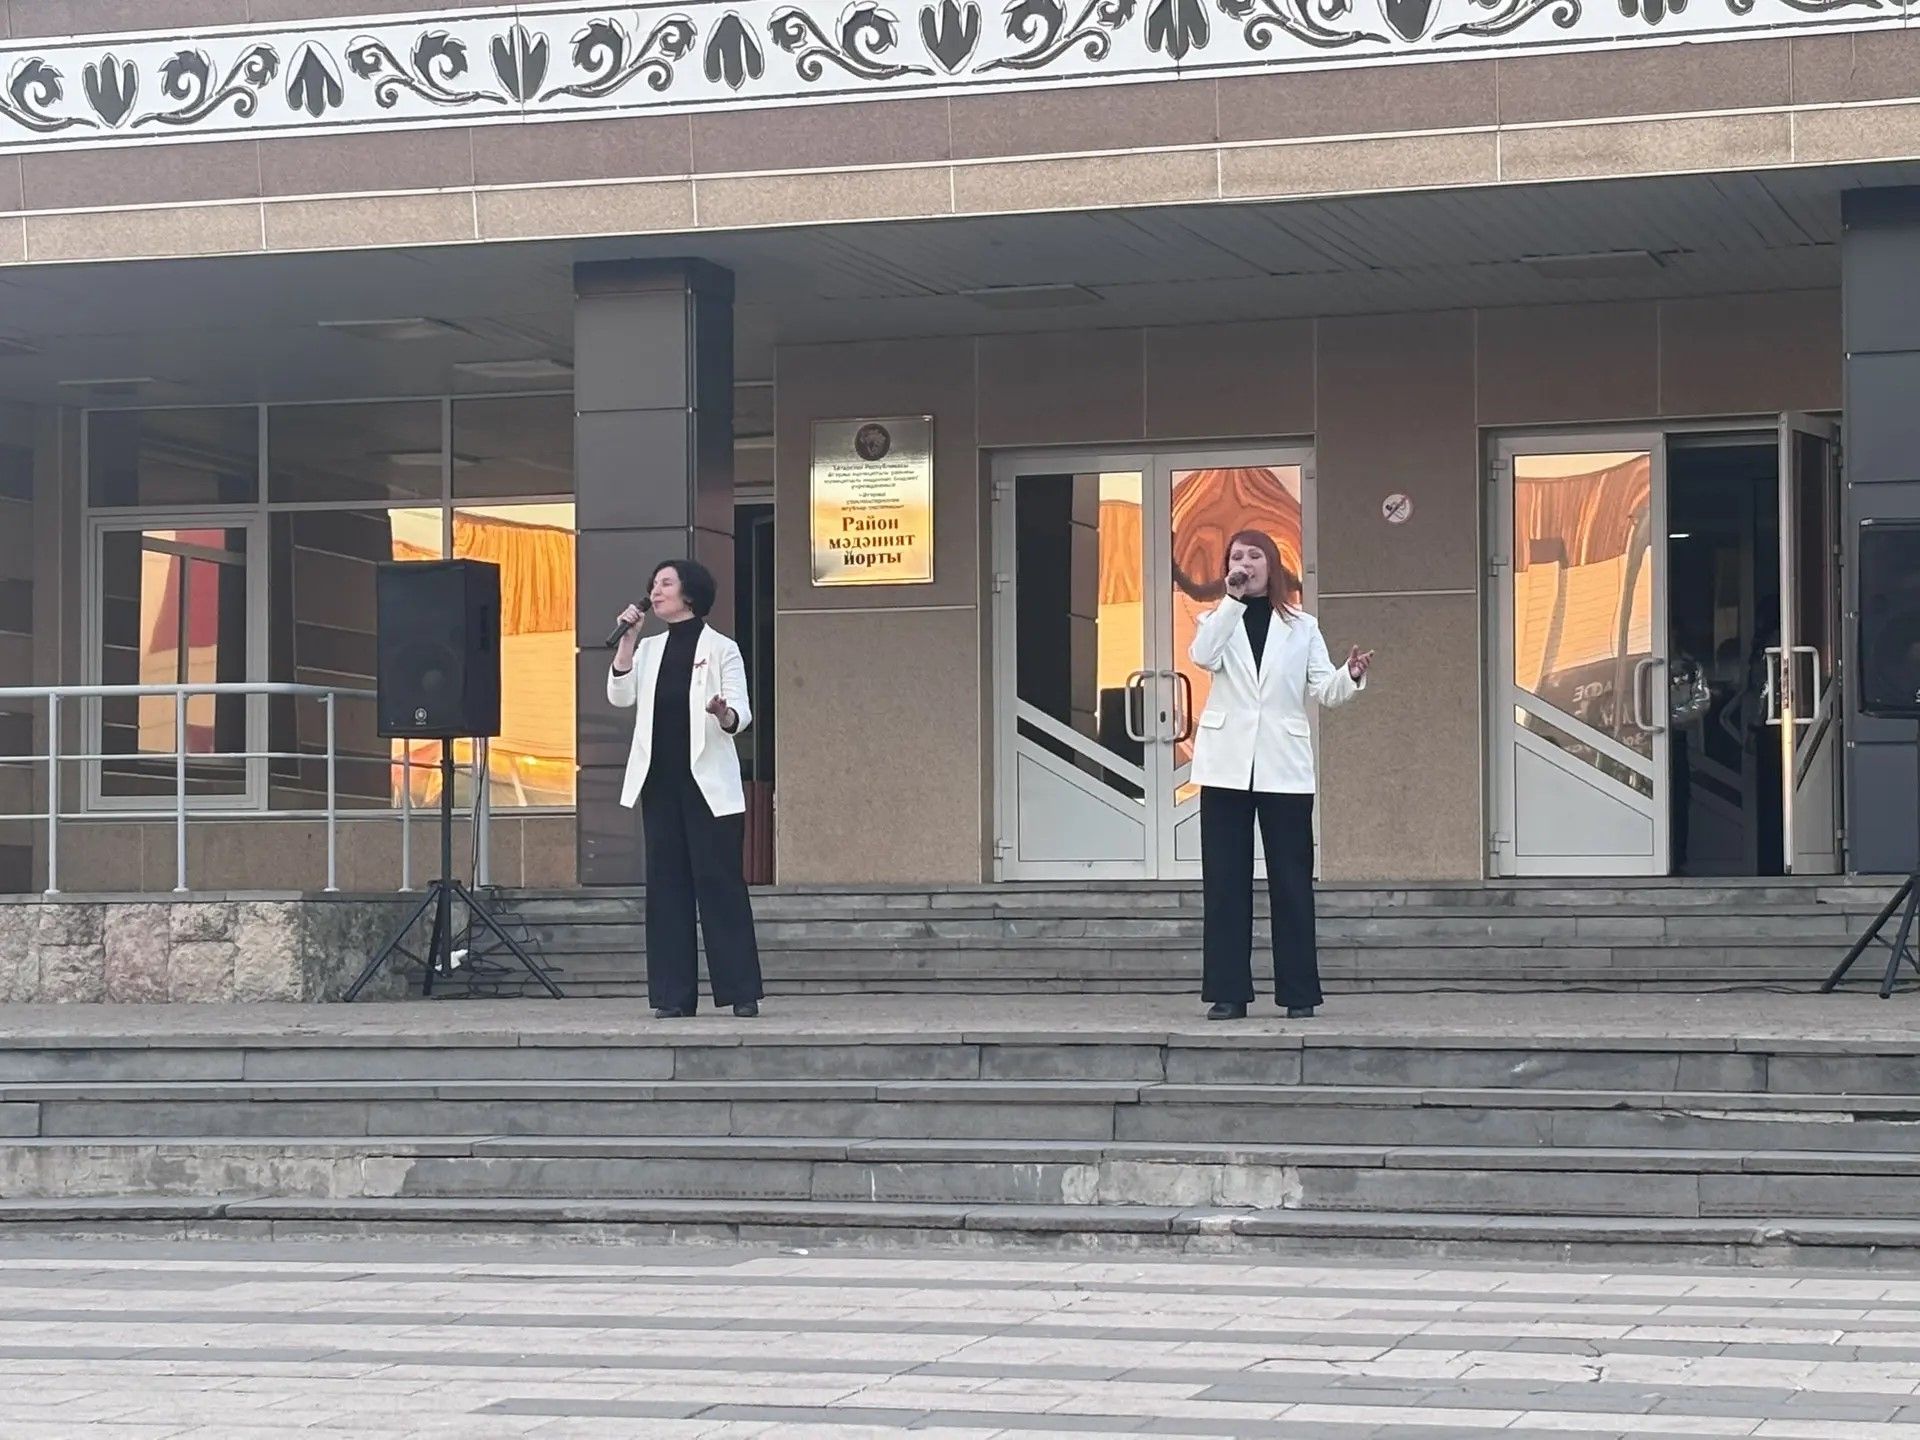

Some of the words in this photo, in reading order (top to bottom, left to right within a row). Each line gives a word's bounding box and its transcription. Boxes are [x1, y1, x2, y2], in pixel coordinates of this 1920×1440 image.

[842, 515, 899, 532] Район
[829, 534, 916, 550] мәдәният
[843, 550, 902, 567] йорты
